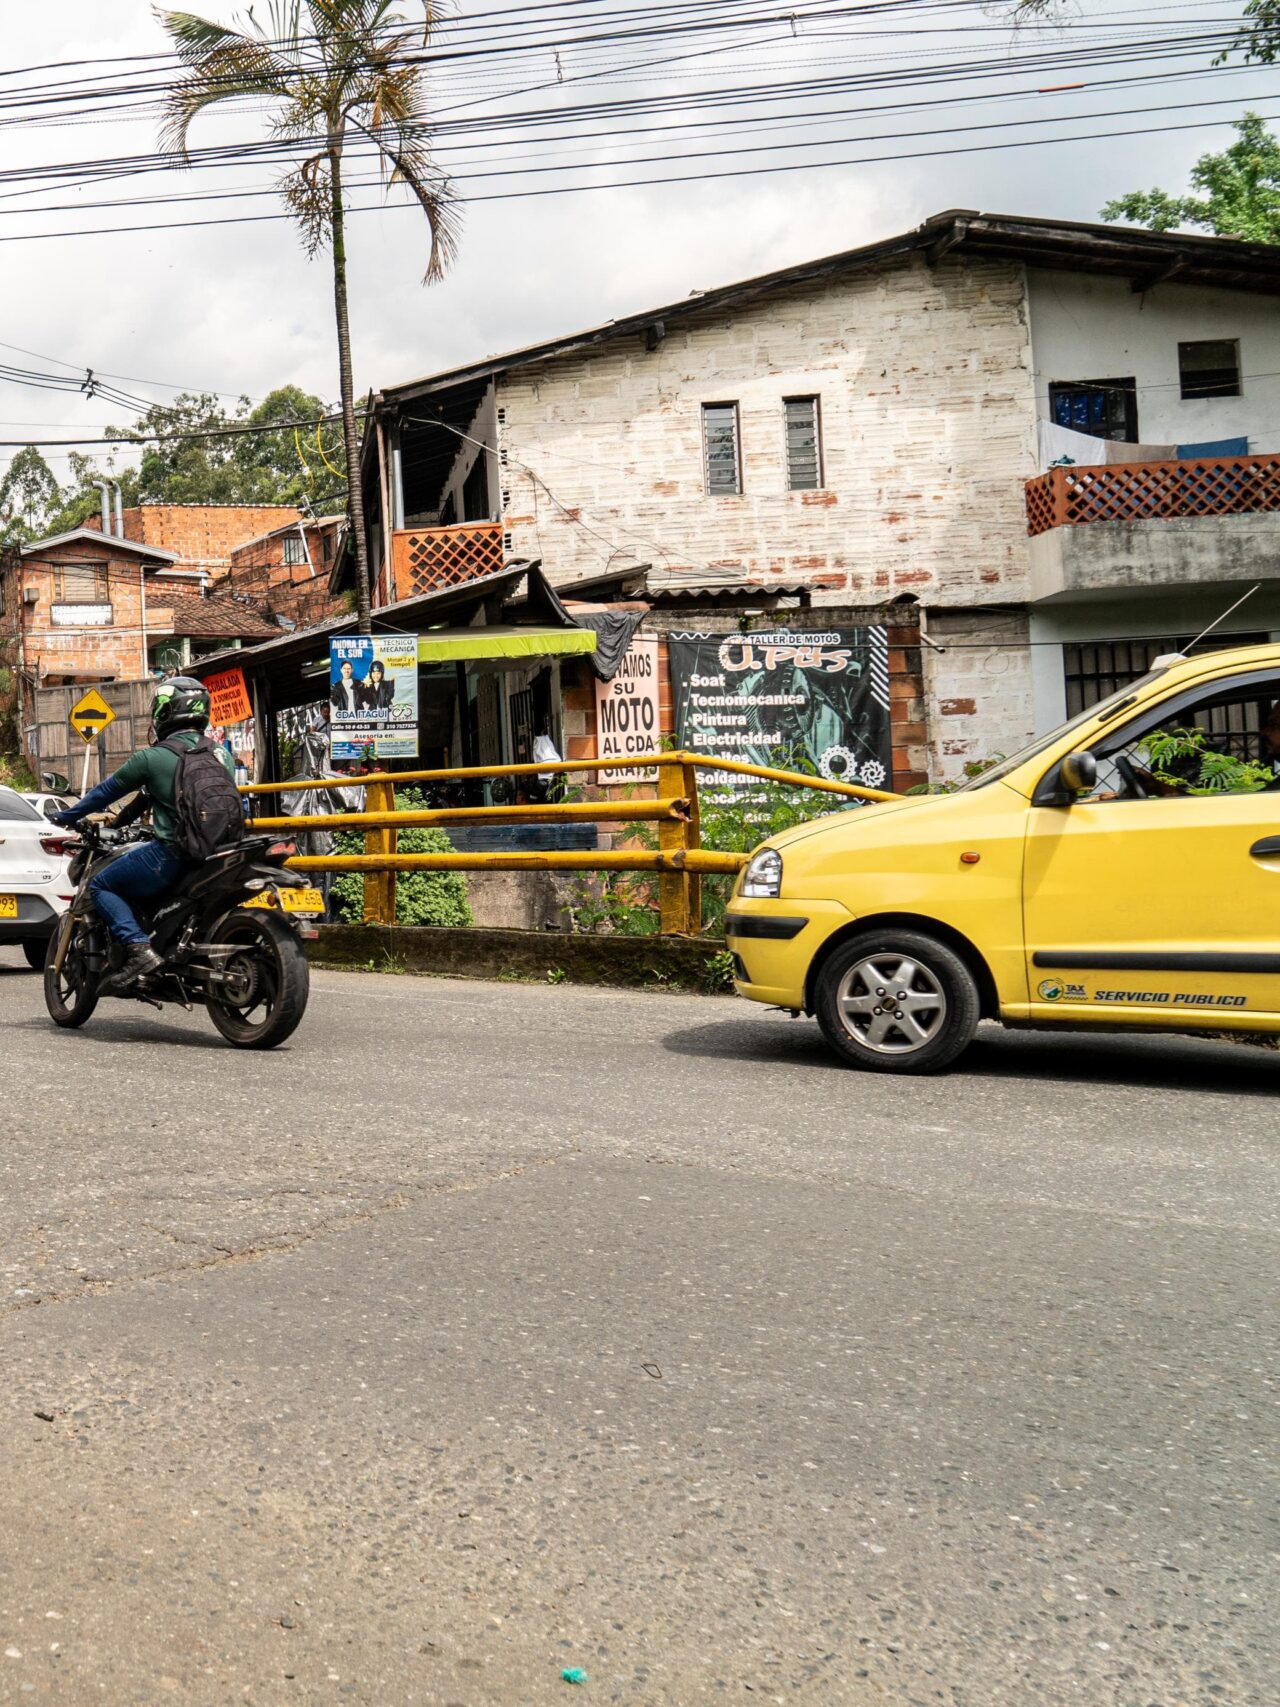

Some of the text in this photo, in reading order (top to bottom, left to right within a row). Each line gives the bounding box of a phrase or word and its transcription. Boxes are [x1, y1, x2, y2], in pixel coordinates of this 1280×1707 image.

[332, 639, 368, 649] AHORA EN
[749, 634, 840, 644] TALLER DE MOTOS
[337, 648, 363, 658] EL SUR
[690, 674, 726, 687] Soat
[614, 682, 635, 695] SU
[691, 693, 805, 706] Tecnomecanica
[335, 711, 356, 719] CDA
[600, 696, 654, 734] MOTO
[692, 712, 747, 726] Pintura
[603, 735, 655, 754] AL CDA
[692, 731, 782, 746] Electricidad
[1065, 984, 1085, 992] TAX
[1093, 990, 1247, 1006] SERVICIO PUBLICO
